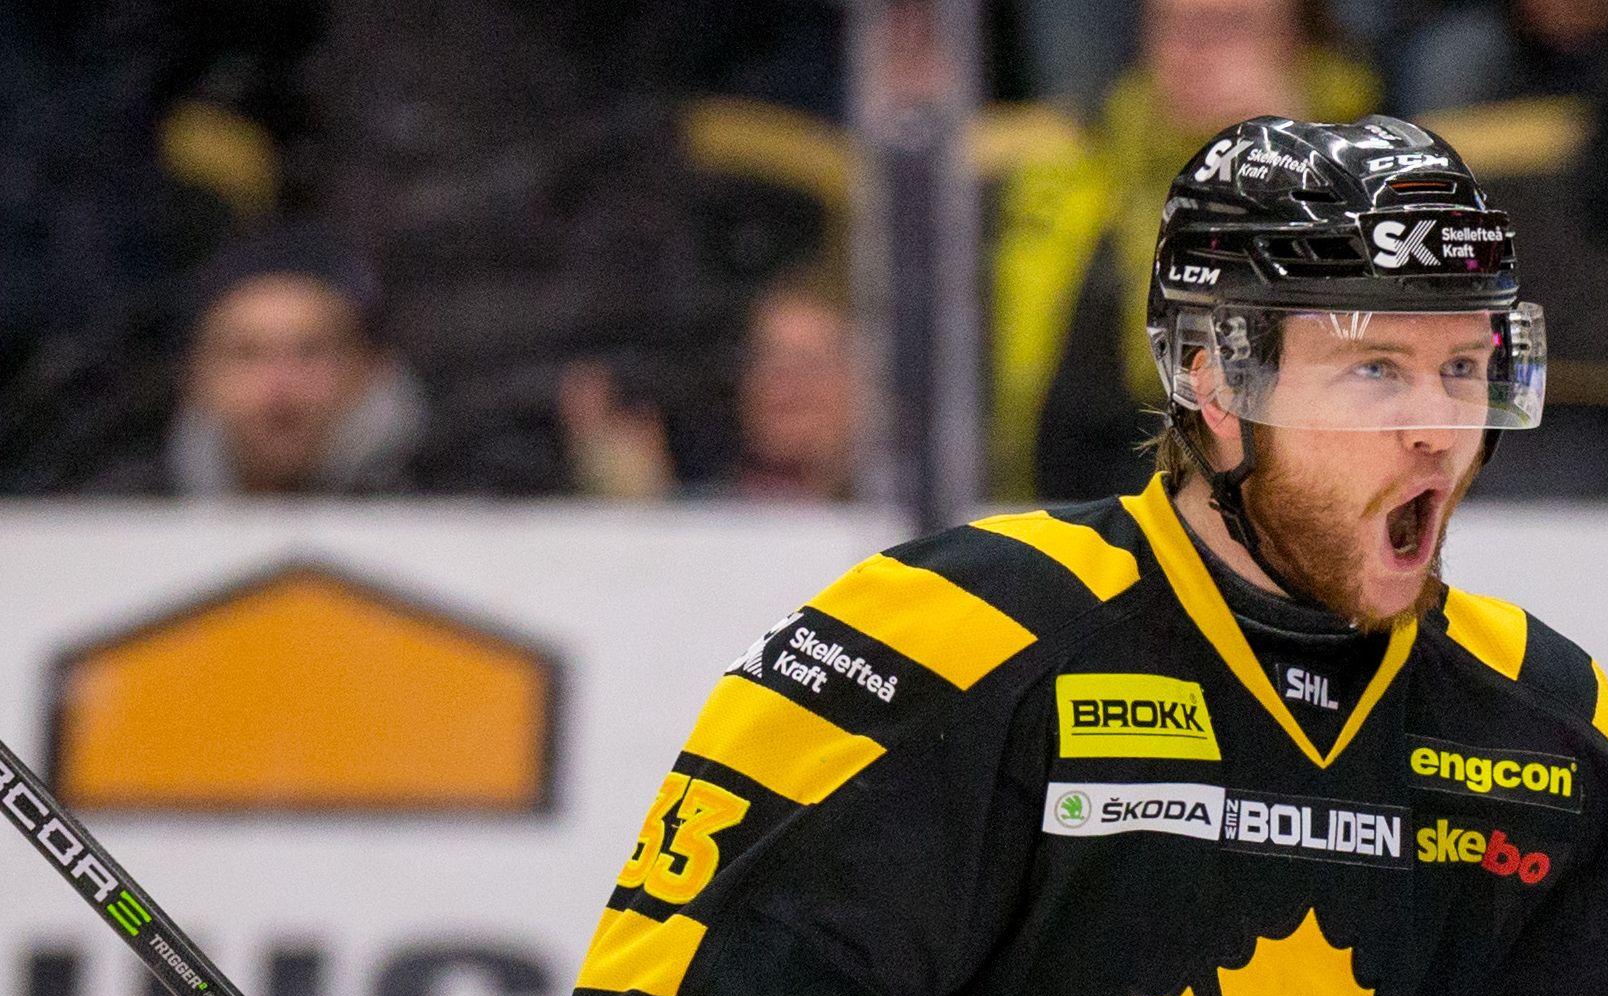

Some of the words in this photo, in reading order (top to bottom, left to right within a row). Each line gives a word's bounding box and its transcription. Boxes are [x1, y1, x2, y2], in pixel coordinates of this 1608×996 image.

[1239, 163, 1268, 180] Kraft
[1441, 226, 1503, 242] Skellefteå
[1442, 244, 1475, 258] Kraft
[773, 650, 828, 693] Kraft
[788, 626, 898, 703] Skellefteå
[1285, 666, 1339, 710] SHL
[1071, 699, 1205, 732] BROKK
[1410, 746, 1573, 797] engcon
[1100, 797, 1212, 826] ŠKODA
[1225, 798, 1239, 840] NEW
[1239, 799, 1401, 857] BOLIDEN
[616, 771, 751, 905] 33
[1417, 818, 1551, 884] skebo
